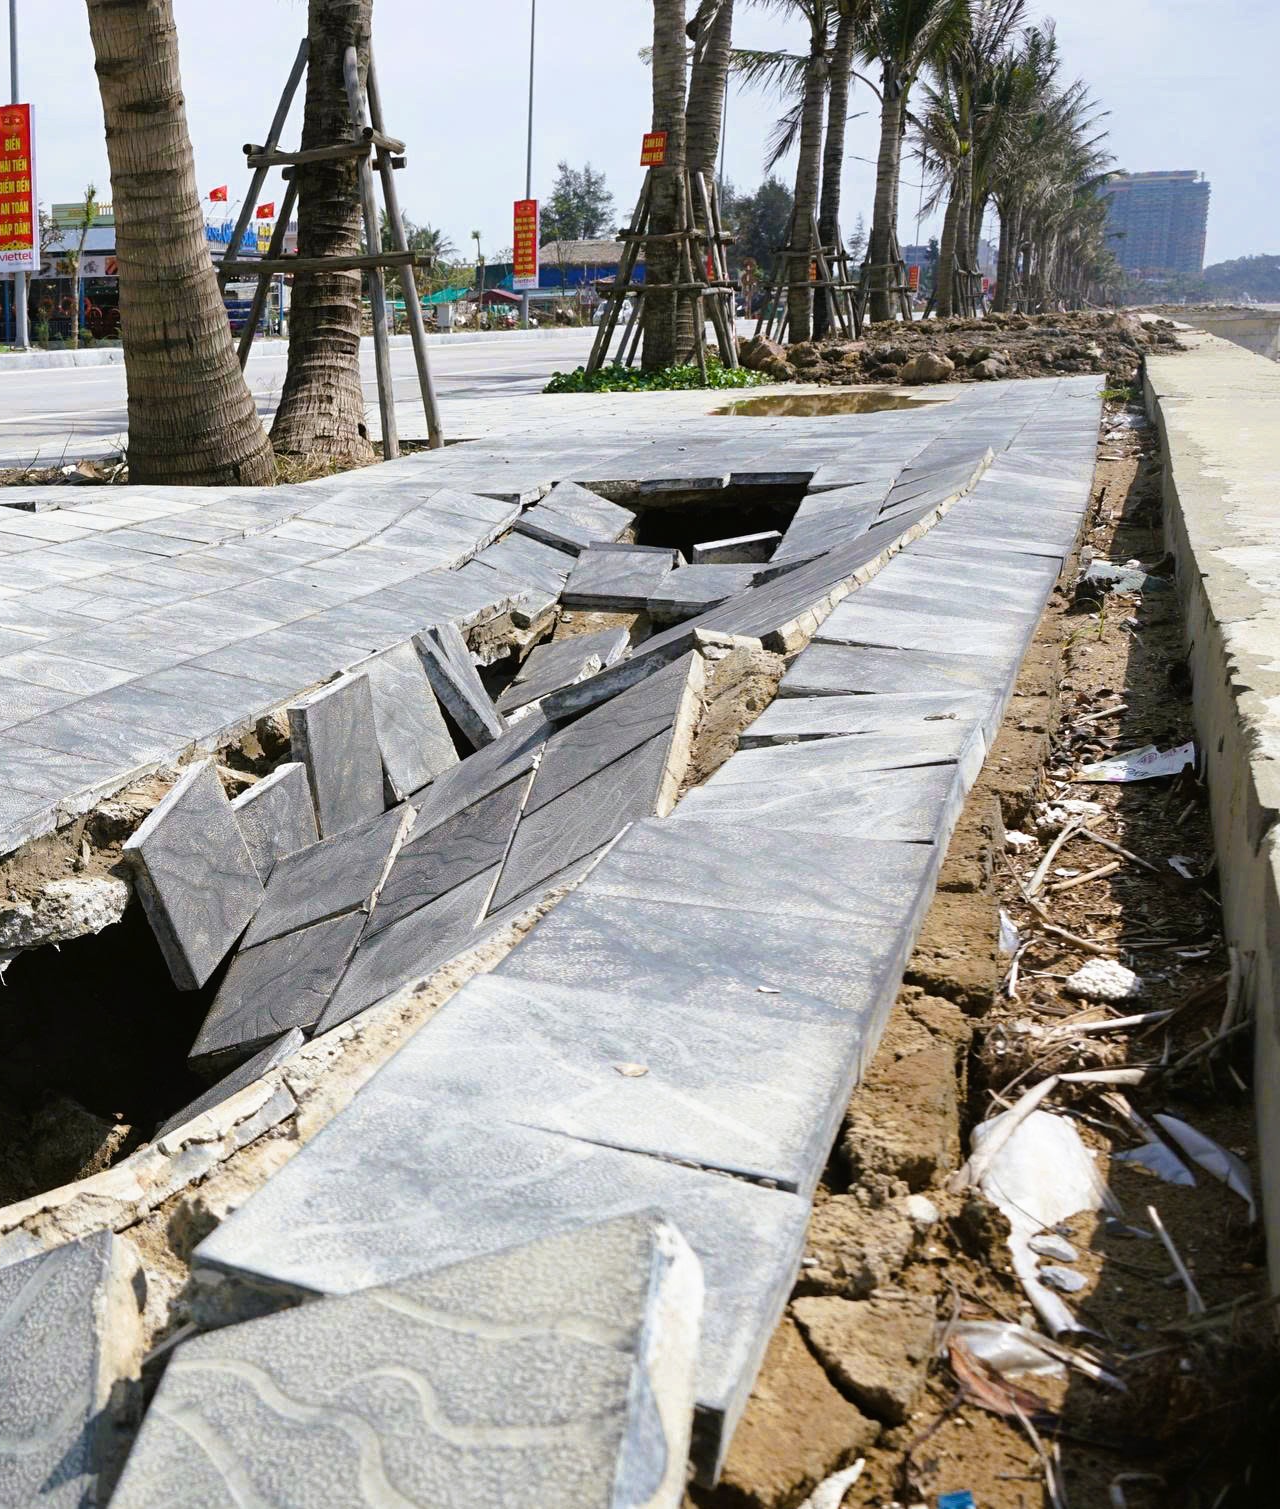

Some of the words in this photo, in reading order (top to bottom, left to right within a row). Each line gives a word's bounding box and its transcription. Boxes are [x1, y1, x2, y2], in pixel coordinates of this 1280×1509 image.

[5, 133, 20, 151] BIỂN
[0, 202, 10, 216] AN
[0, 251, 33, 262] viettel
